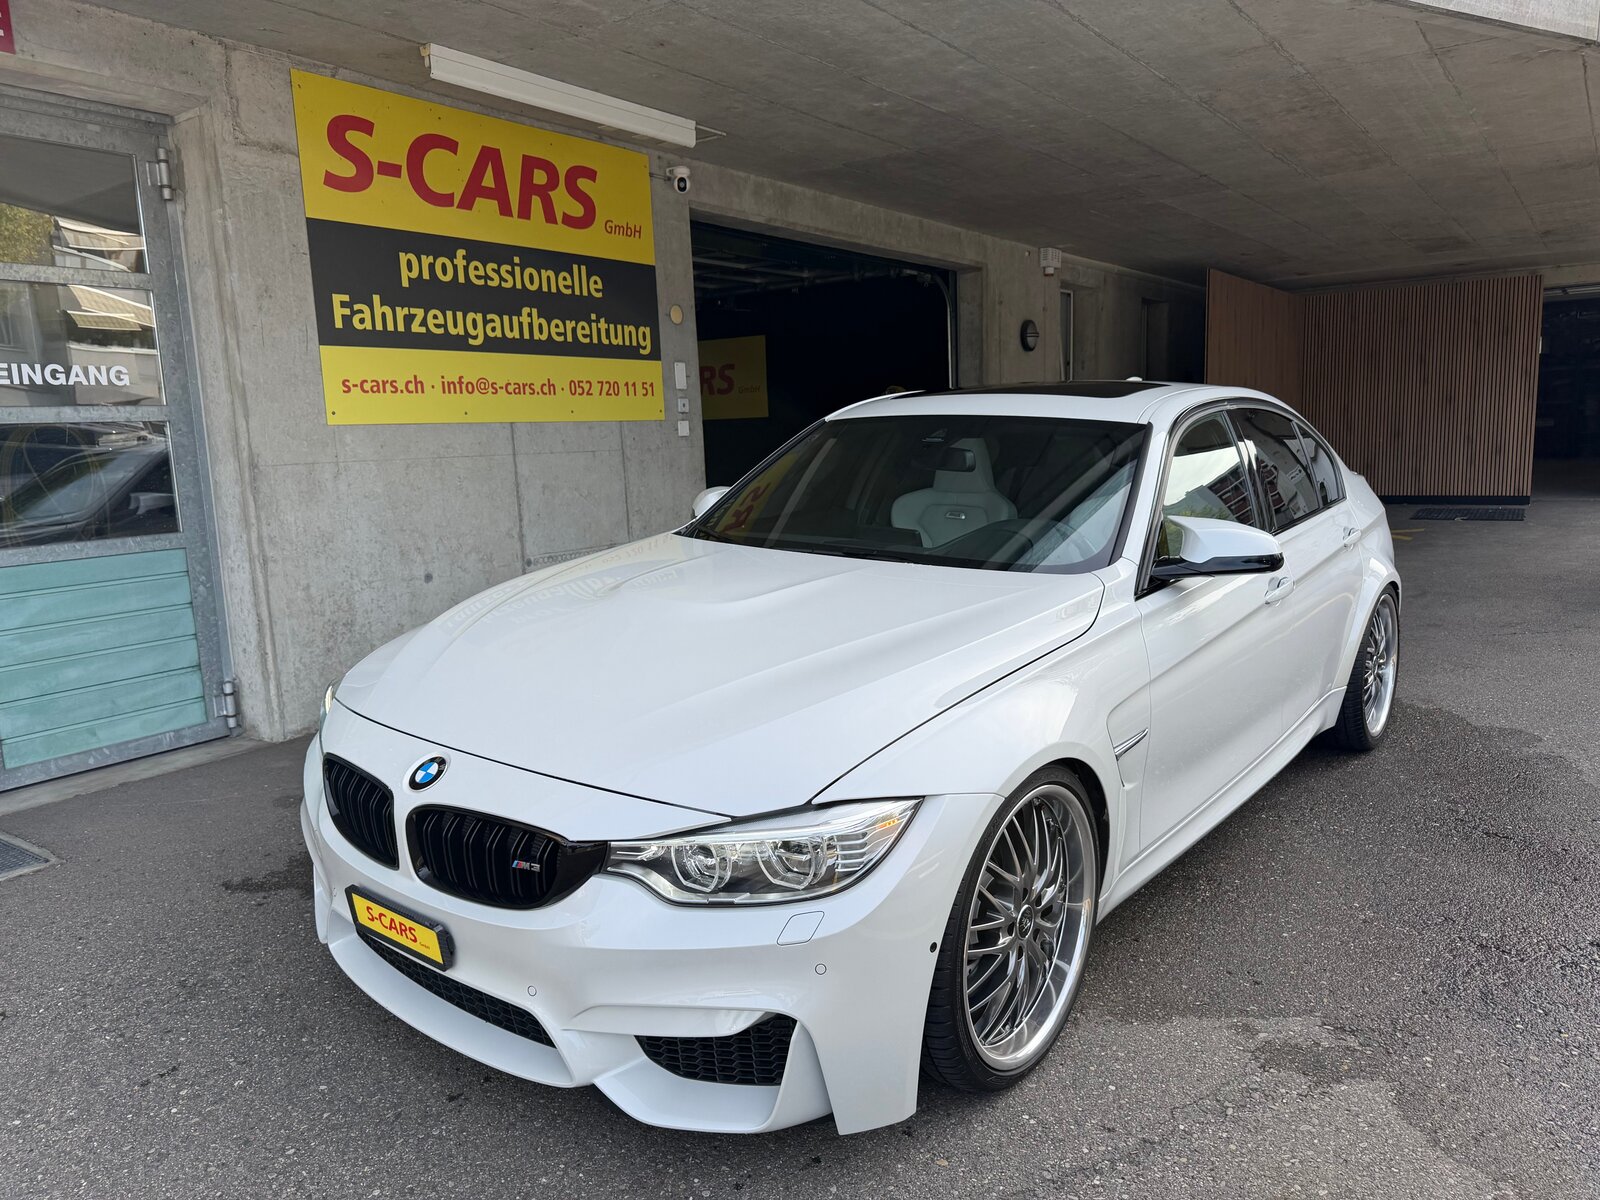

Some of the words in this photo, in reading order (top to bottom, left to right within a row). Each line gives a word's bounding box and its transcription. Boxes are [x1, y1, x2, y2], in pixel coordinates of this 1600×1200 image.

[323, 114, 598, 230] S-CARS
[604, 219, 642, 239] GmbH
[398, 248, 604, 298] professionelle
[331, 293, 652, 355] Fahrzeugaufbereitung
[341, 374, 425, 394] s-cars.ch
[440, 375, 557, 396] info@s-cars.ch
[569, 379, 593, 396] 052
[597, 380, 620, 397] 720
[623, 381, 637, 397] 11
[642, 381, 655, 397] 51
[366, 905, 418, 944] S-CARS
